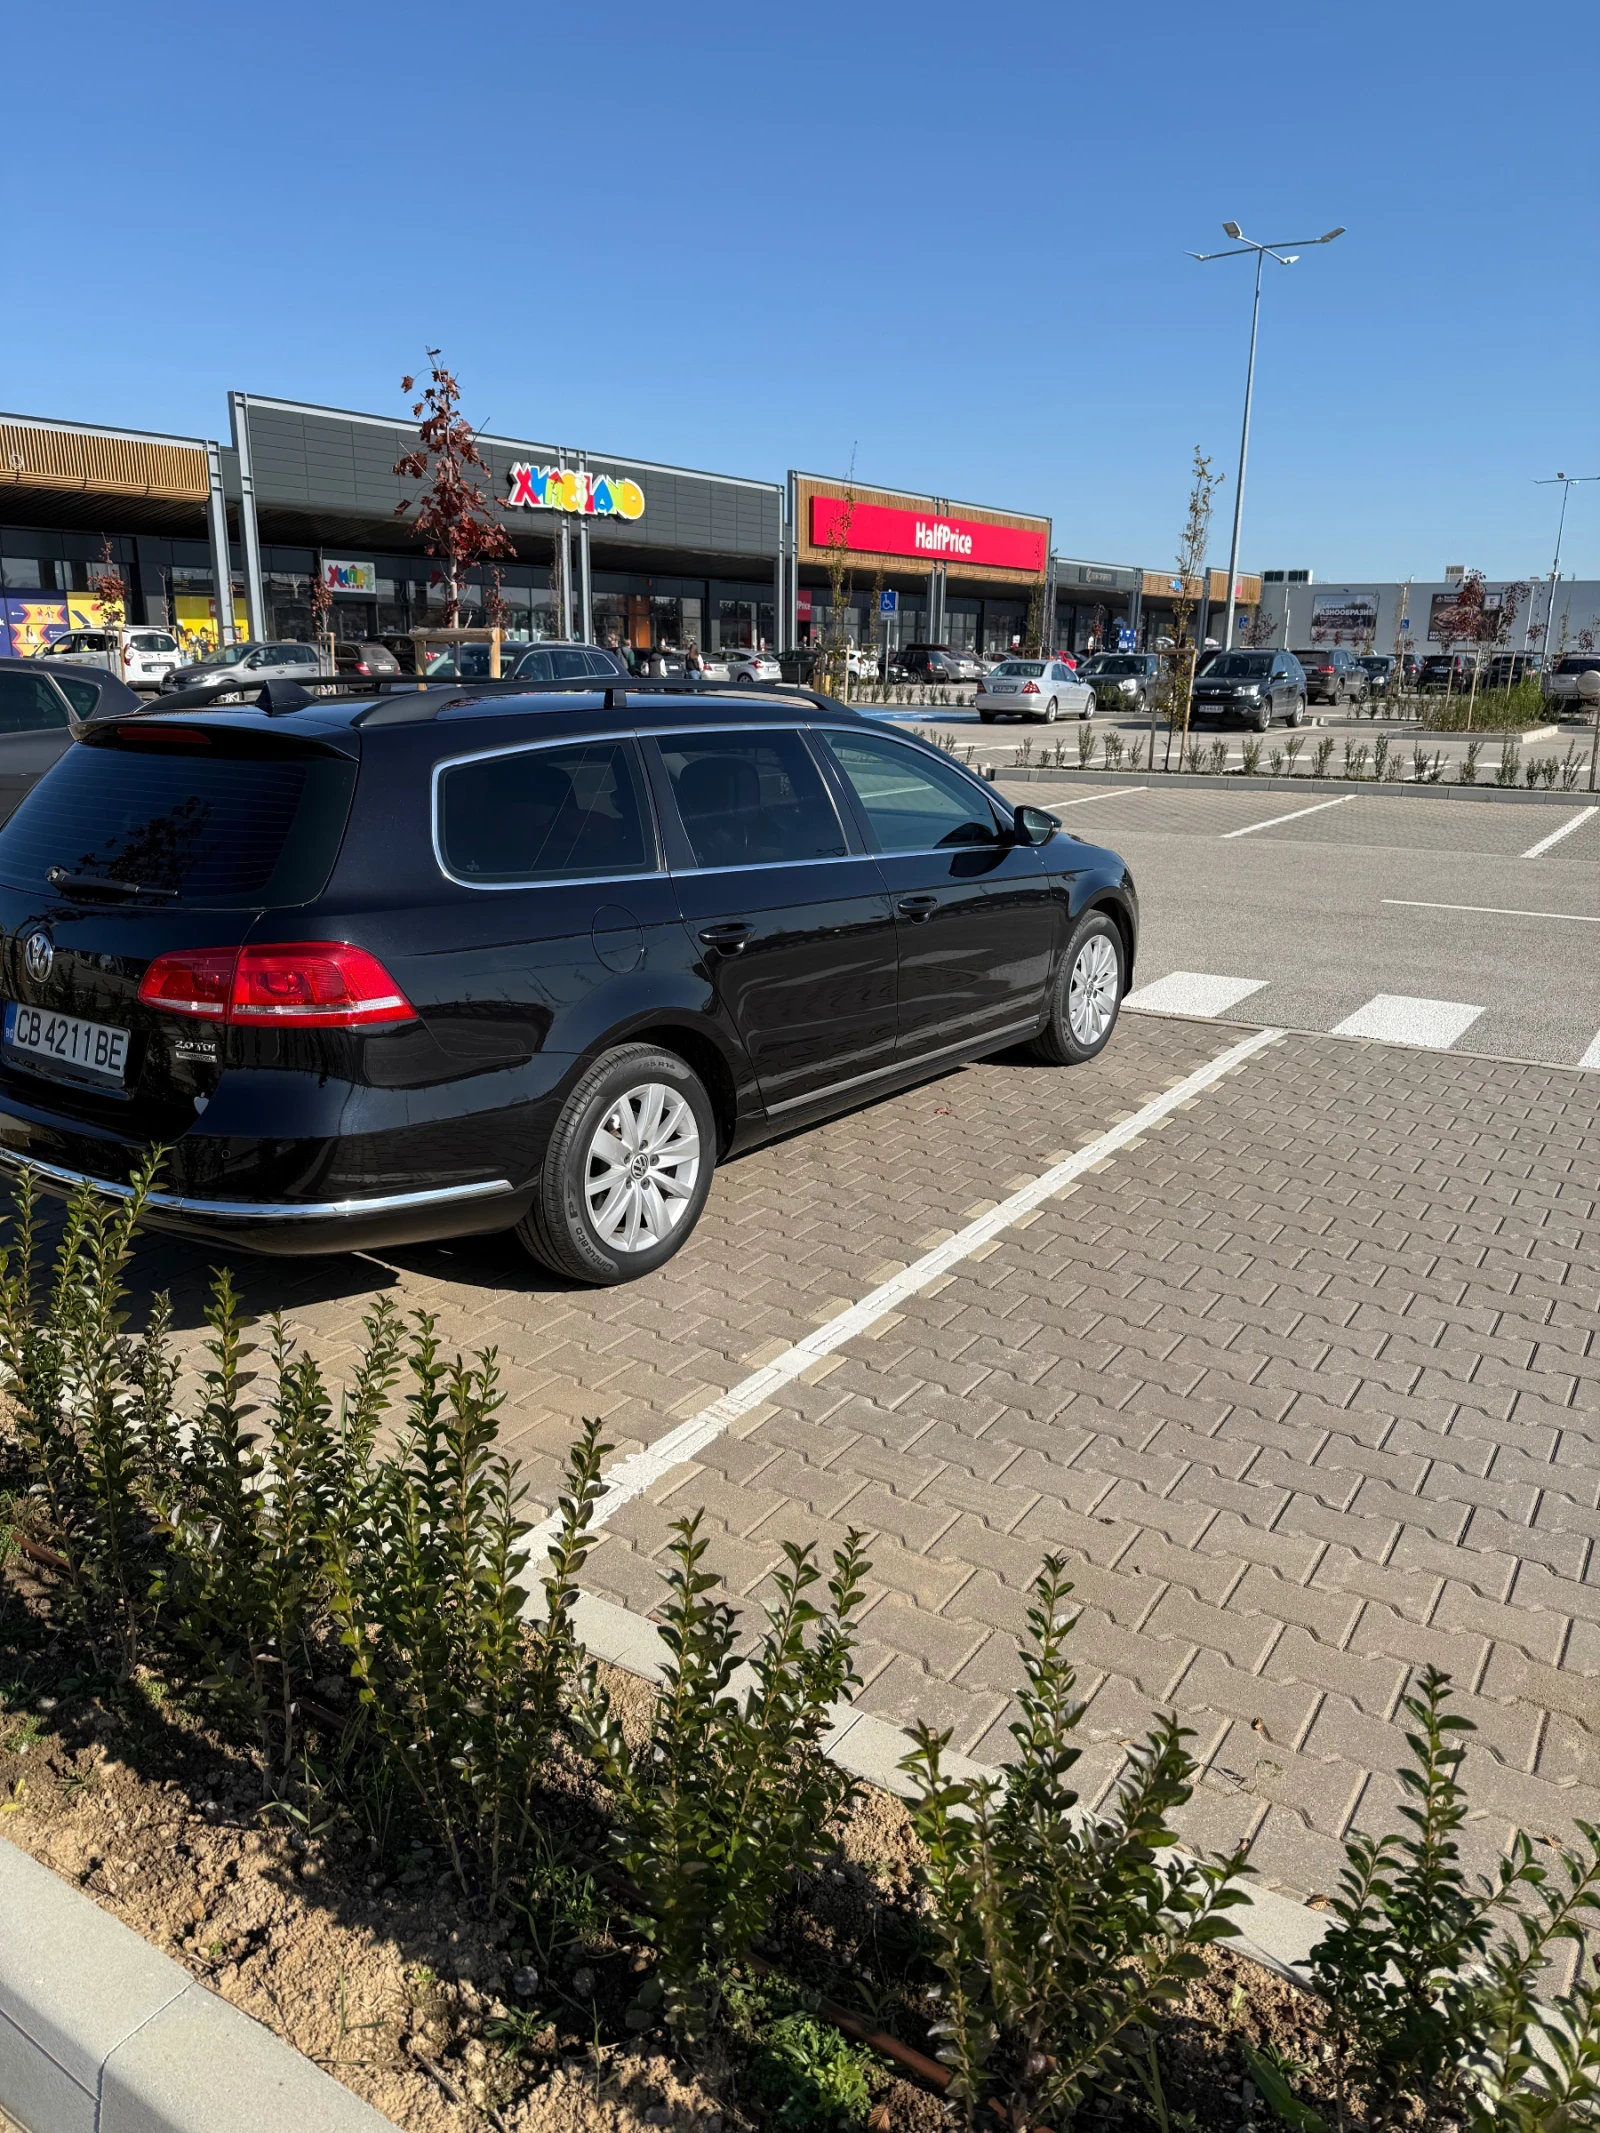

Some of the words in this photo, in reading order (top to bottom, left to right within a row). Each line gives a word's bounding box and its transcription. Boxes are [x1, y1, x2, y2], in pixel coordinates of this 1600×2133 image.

[915, 521, 972, 554] HalfPrice
[5, 1027, 14, 1039] BG
[17, 1009, 42, 1047] CB
[44, 1017, 92, 1062] 4211
[94, 1030, 125, 1071] BE
[174, 1040, 194, 1050] 2.0
[194, 1042, 216, 1052] TDI
[576, 1227, 614, 1273] Cinturato
